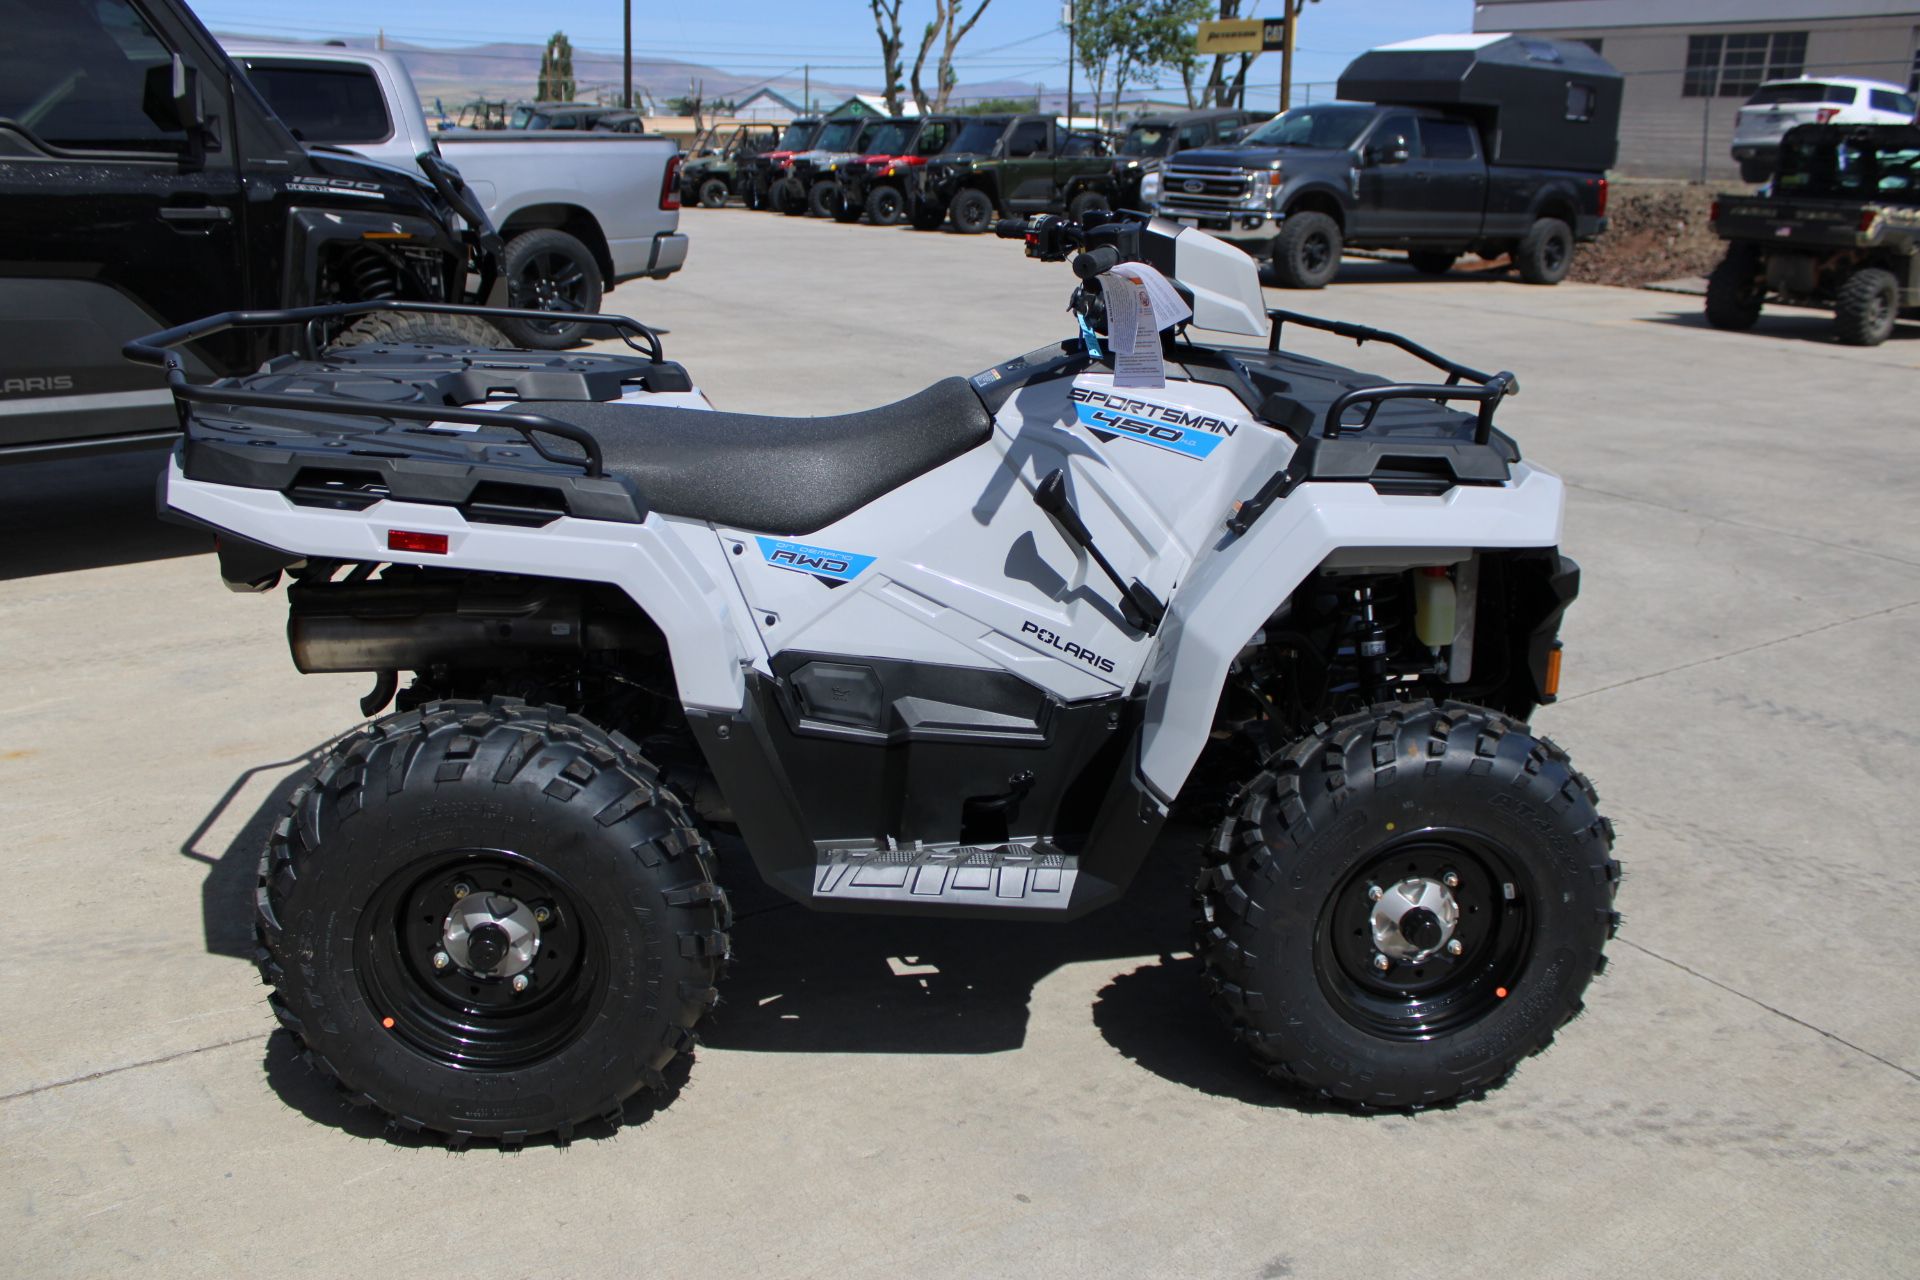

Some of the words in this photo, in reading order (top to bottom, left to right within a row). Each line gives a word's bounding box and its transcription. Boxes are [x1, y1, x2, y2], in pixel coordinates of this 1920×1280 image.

[0, 375, 74, 393] ARIS
[1066, 387, 1239, 437] SPORTSMAN
[1092, 410, 1184, 443] 450
[770, 549, 849, 573] AWD
[1021, 620, 1116, 674] POLARIS
